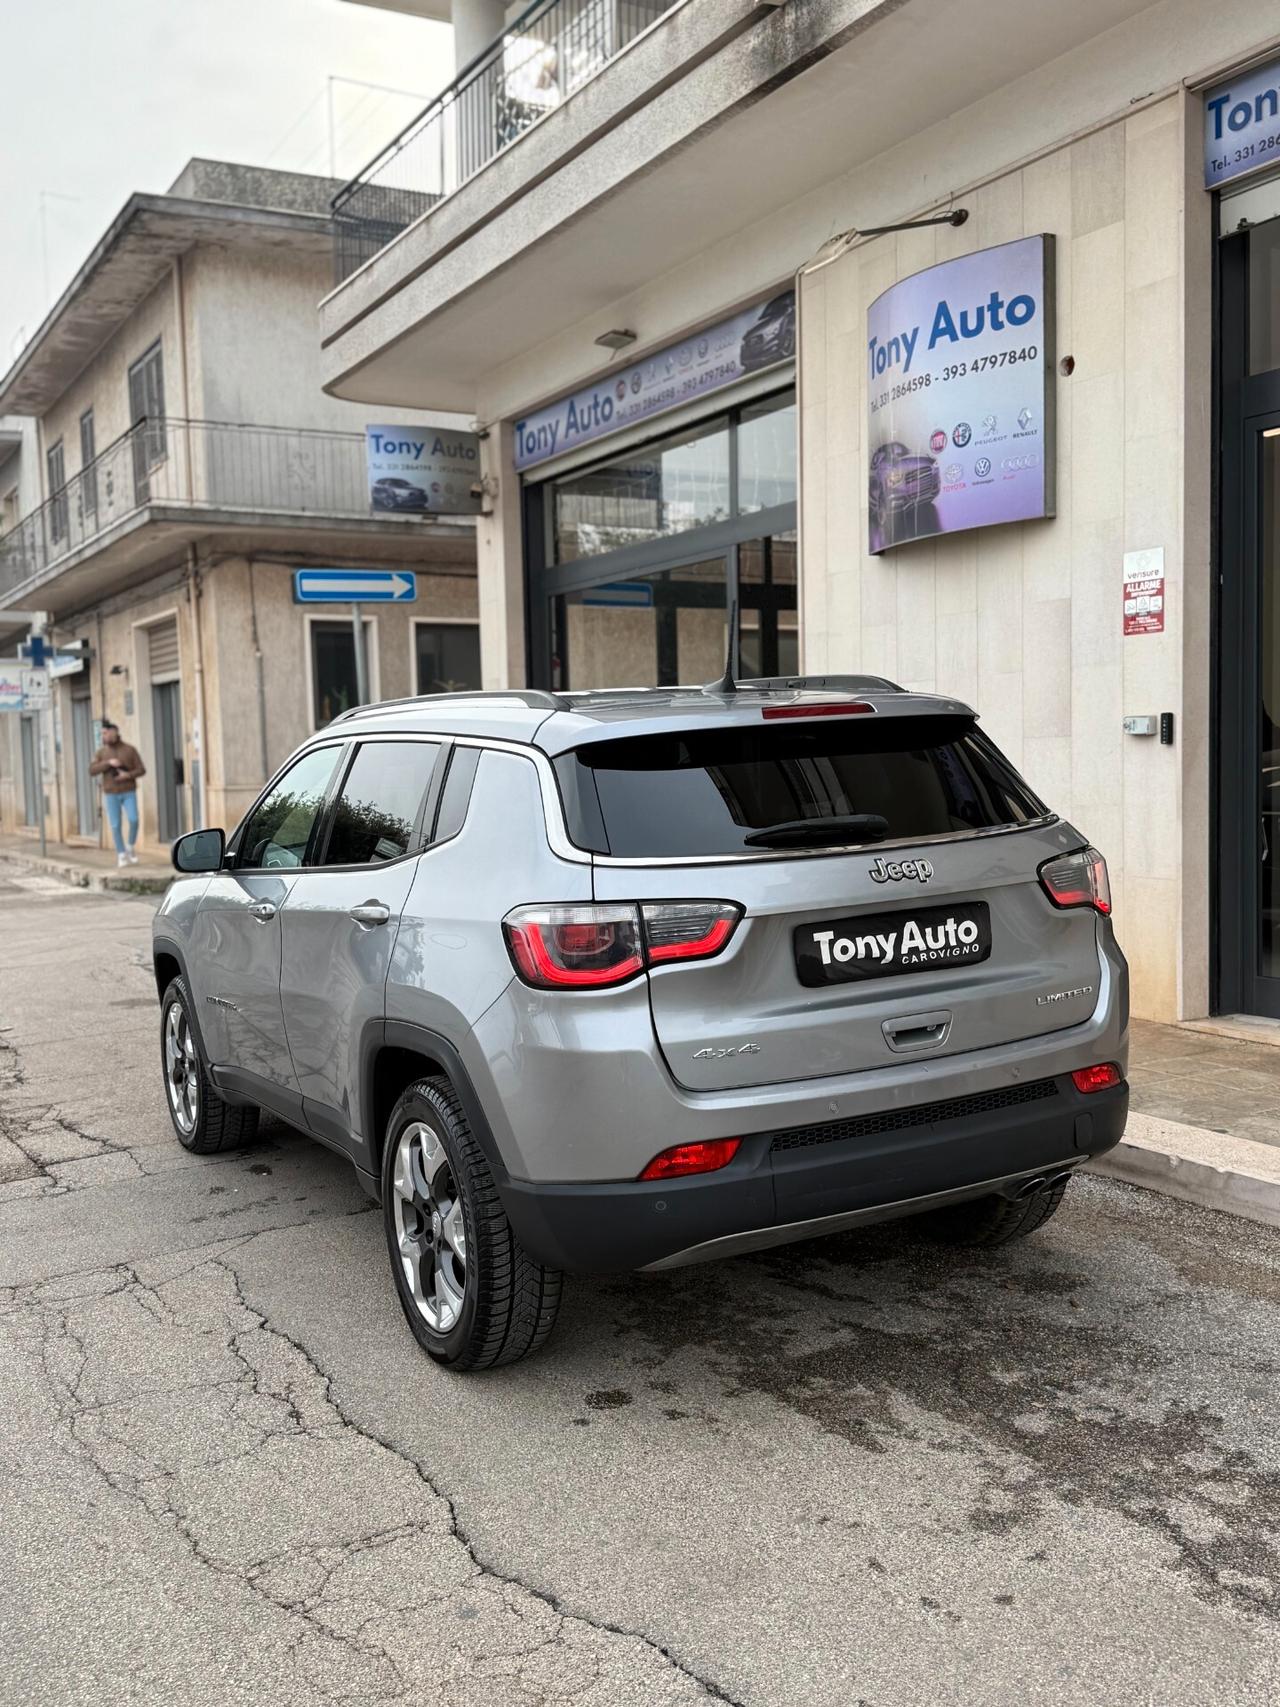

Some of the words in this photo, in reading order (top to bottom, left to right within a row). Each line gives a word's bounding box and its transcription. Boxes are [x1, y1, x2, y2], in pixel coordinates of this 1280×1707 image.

[1208, 86, 1280, 140] Ton
[1211, 155, 1231, 172] Tel.
[1235, 144, 1255, 163] 331
[869, 326, 919, 380] Tony
[928, 291, 1036, 350] Auto
[891, 373, 932, 401] 2864598
[943, 362, 967, 381] 393
[970, 345, 1038, 373] 4797840
[516, 419, 560, 457] Tony
[564, 394, 613, 439] Auto
[1013, 429, 1037, 438] RENAULT
[370, 434, 425, 460] Tony
[431, 438, 477, 460] Auto
[1126, 580, 1161, 592] ALLARME
[869, 857, 934, 884] Jeep
[902, 943, 979, 964] CAROVIGNO
[1036, 986, 1092, 1005] LIMITED
